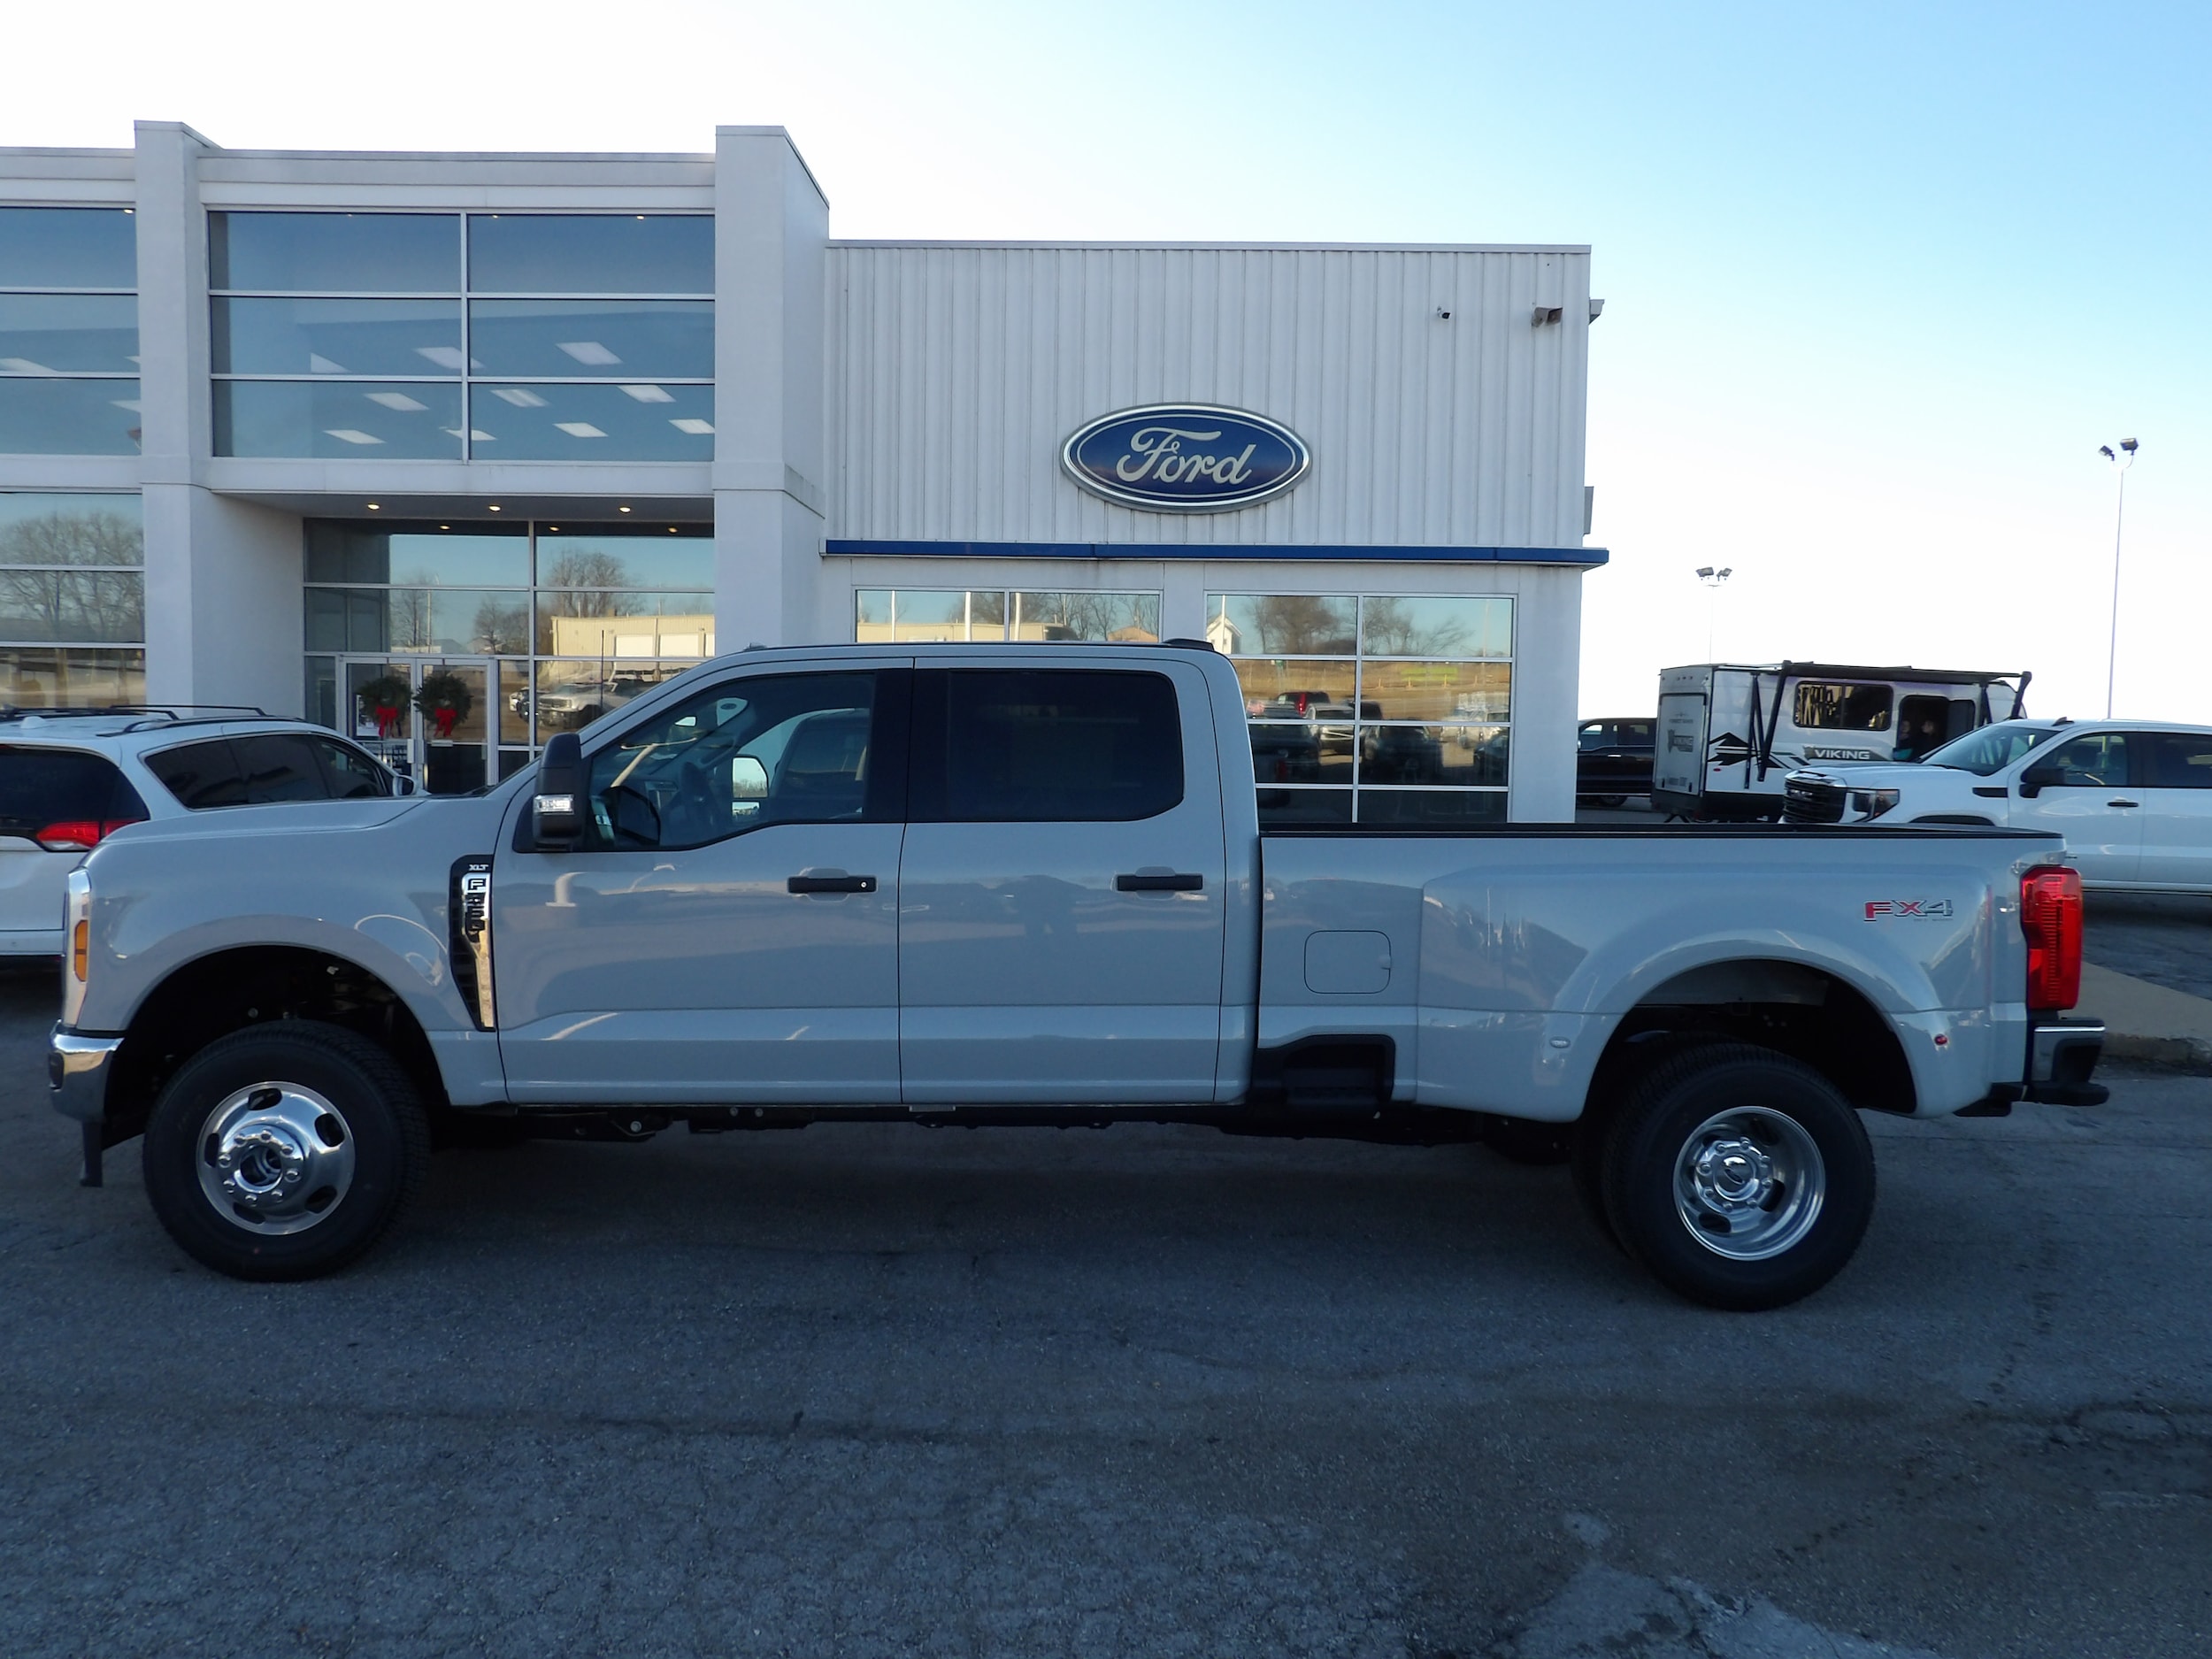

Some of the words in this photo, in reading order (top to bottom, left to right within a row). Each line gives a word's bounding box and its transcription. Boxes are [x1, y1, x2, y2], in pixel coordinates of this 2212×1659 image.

[1116, 426, 1256, 484] Ford
[1814, 749, 1870, 760] VIKING
[1863, 899, 1954, 921] FX4
